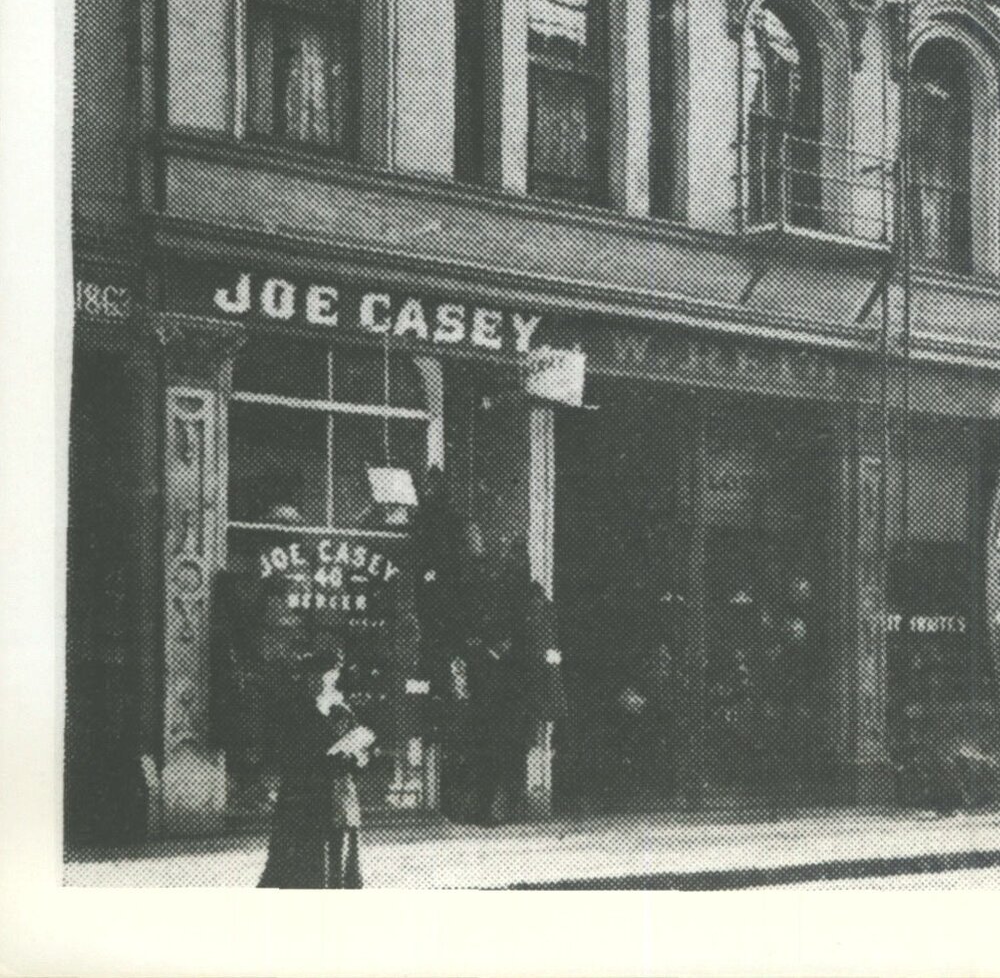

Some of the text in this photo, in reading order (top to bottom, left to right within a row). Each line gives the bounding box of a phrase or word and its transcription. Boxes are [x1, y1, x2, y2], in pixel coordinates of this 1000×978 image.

[214, 271, 544, 352] JOE CASEY
[260, 538, 401, 583] JOE CASEY
